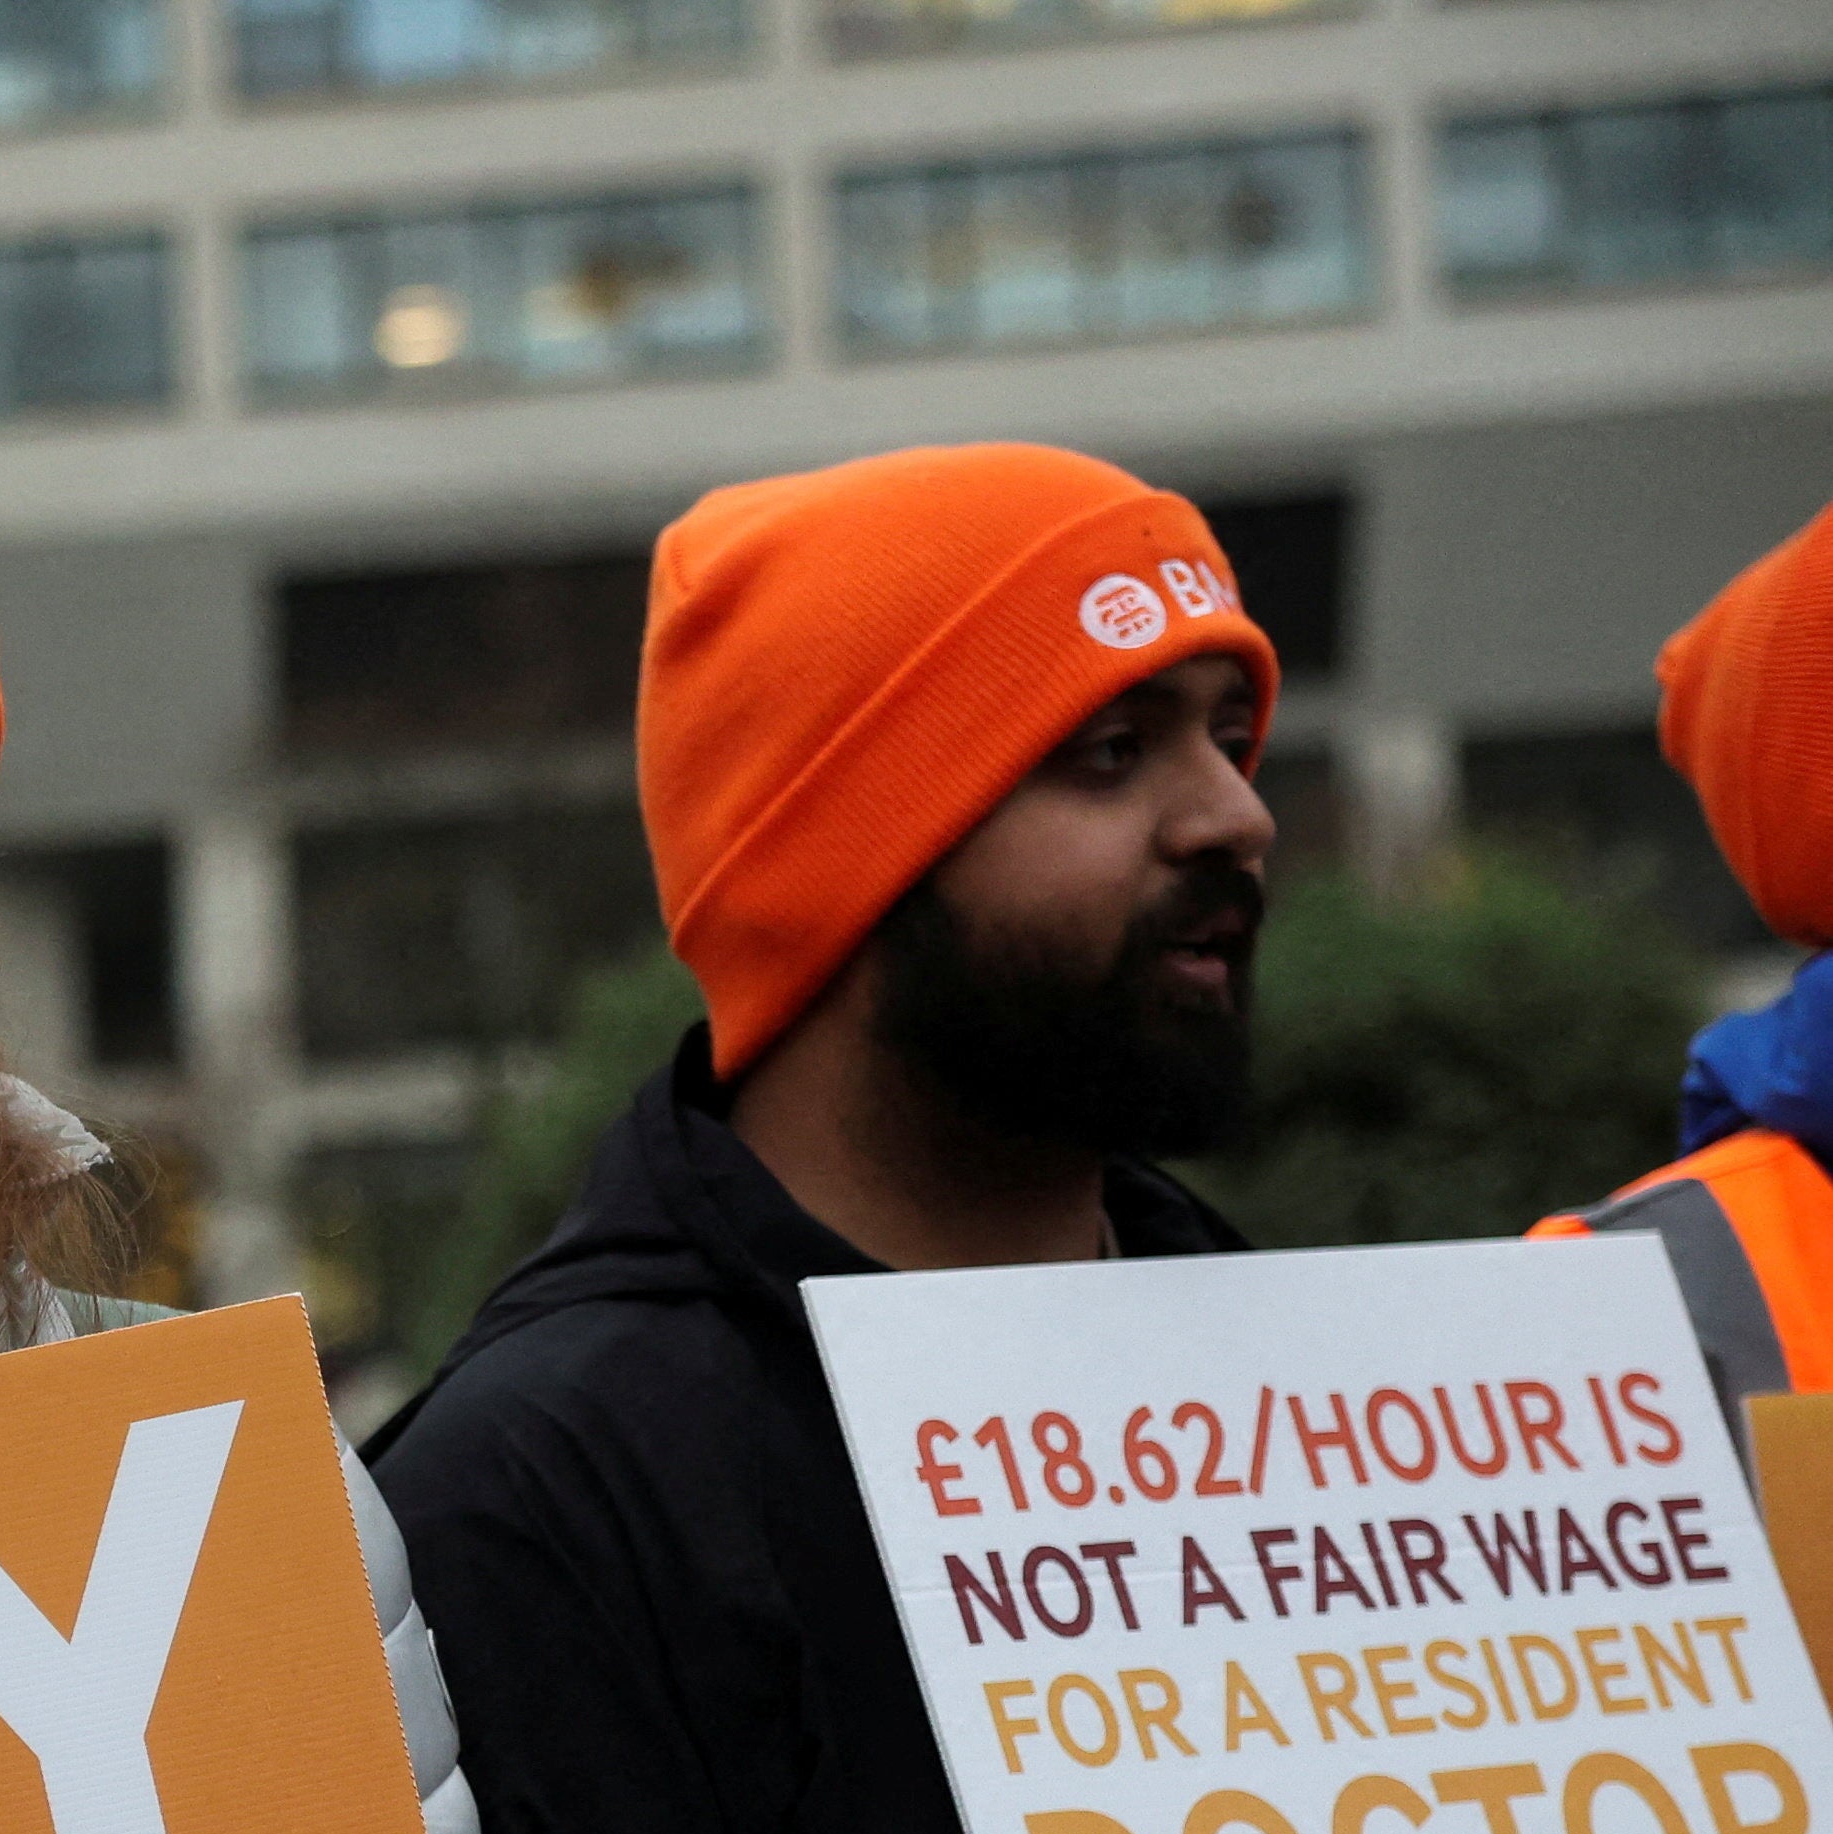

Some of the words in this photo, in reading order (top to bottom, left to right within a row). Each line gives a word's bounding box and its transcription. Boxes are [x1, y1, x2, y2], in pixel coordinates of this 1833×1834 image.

[914, 1379, 1584, 1520] £18.62/HOUR
[1587, 1372, 1684, 1468] IS
[943, 1540, 1141, 1647] NOT
[1181, 1538, 1248, 1627] A
[1250, 1518, 1464, 1619] FAIR
[1461, 1496, 1730, 1602] WAGE
[981, 1666, 1199, 1774] FOR
[1223, 1659, 1291, 1752] A
[1297, 1616, 1760, 1741] RESIDENT
